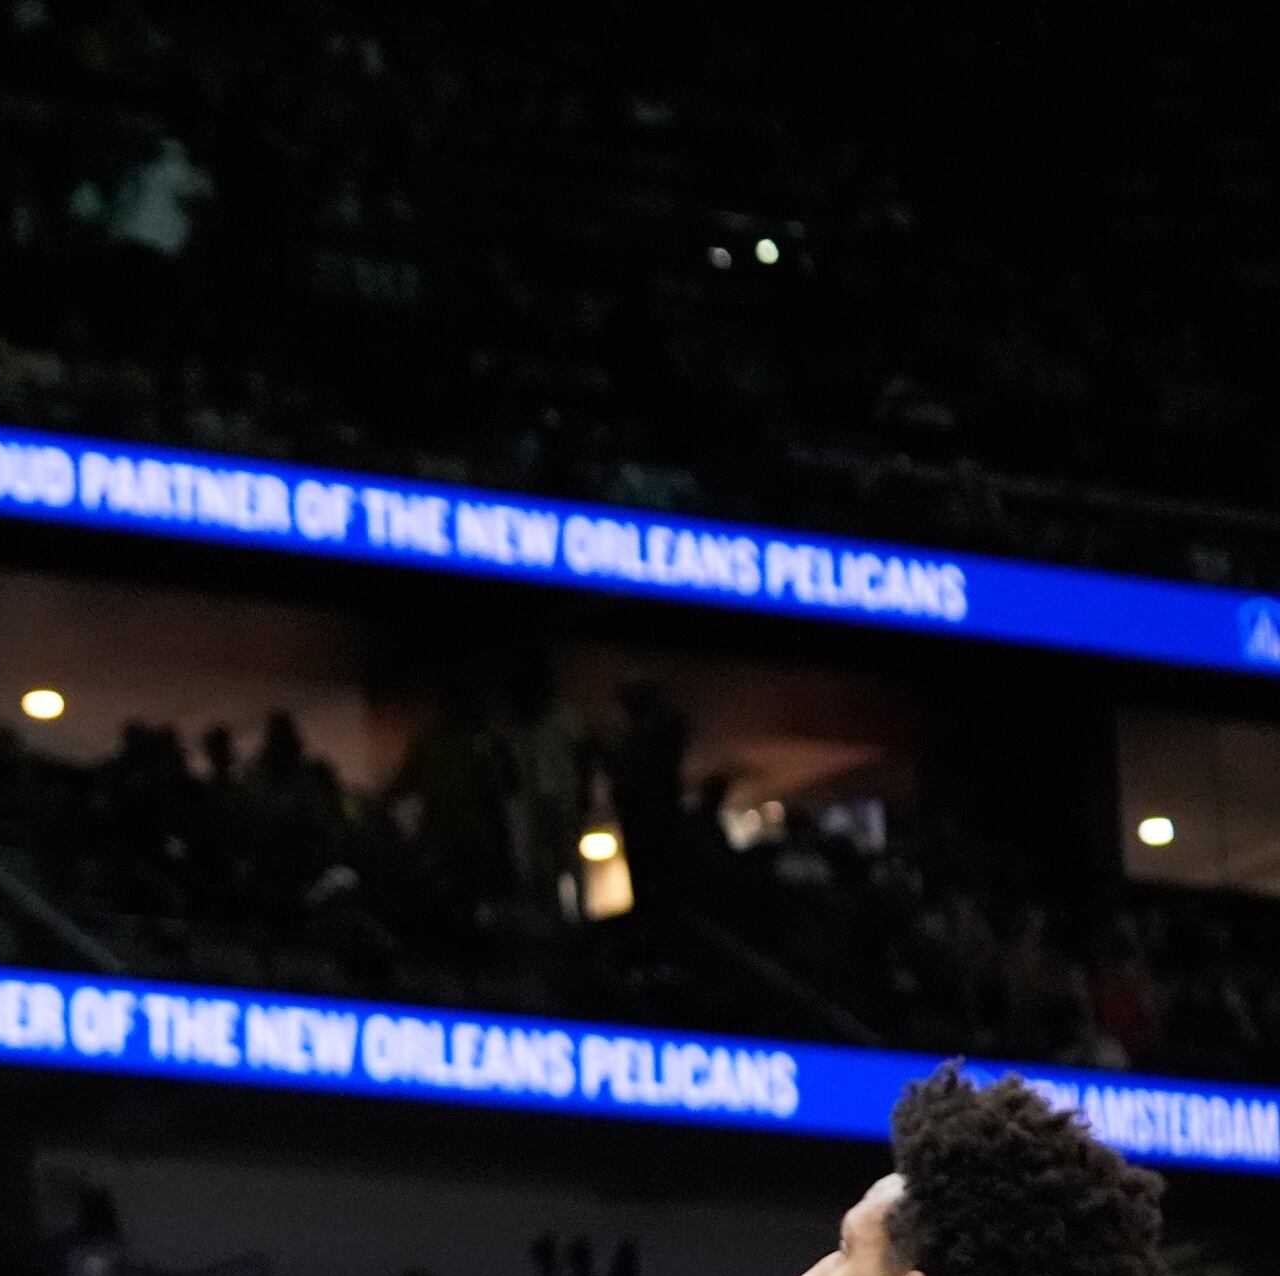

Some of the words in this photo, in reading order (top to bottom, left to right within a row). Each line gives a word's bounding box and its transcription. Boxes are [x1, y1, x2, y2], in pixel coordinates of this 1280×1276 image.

[79, 452, 291, 533] PARTNER
[295, 479, 352, 540] OF
[362, 488, 451, 555] THE
[456, 503, 559, 568] NEW
[562, 515, 760, 596] ORLEANS
[765, 541, 967, 621] PELICANS
[69, 987, 135, 1057] OF
[141, 993, 241, 1068] THE
[245, 1004, 357, 1076] NEW
[362, 1013, 576, 1098] ORLEANS
[580, 1035, 798, 1119] PELICANS
